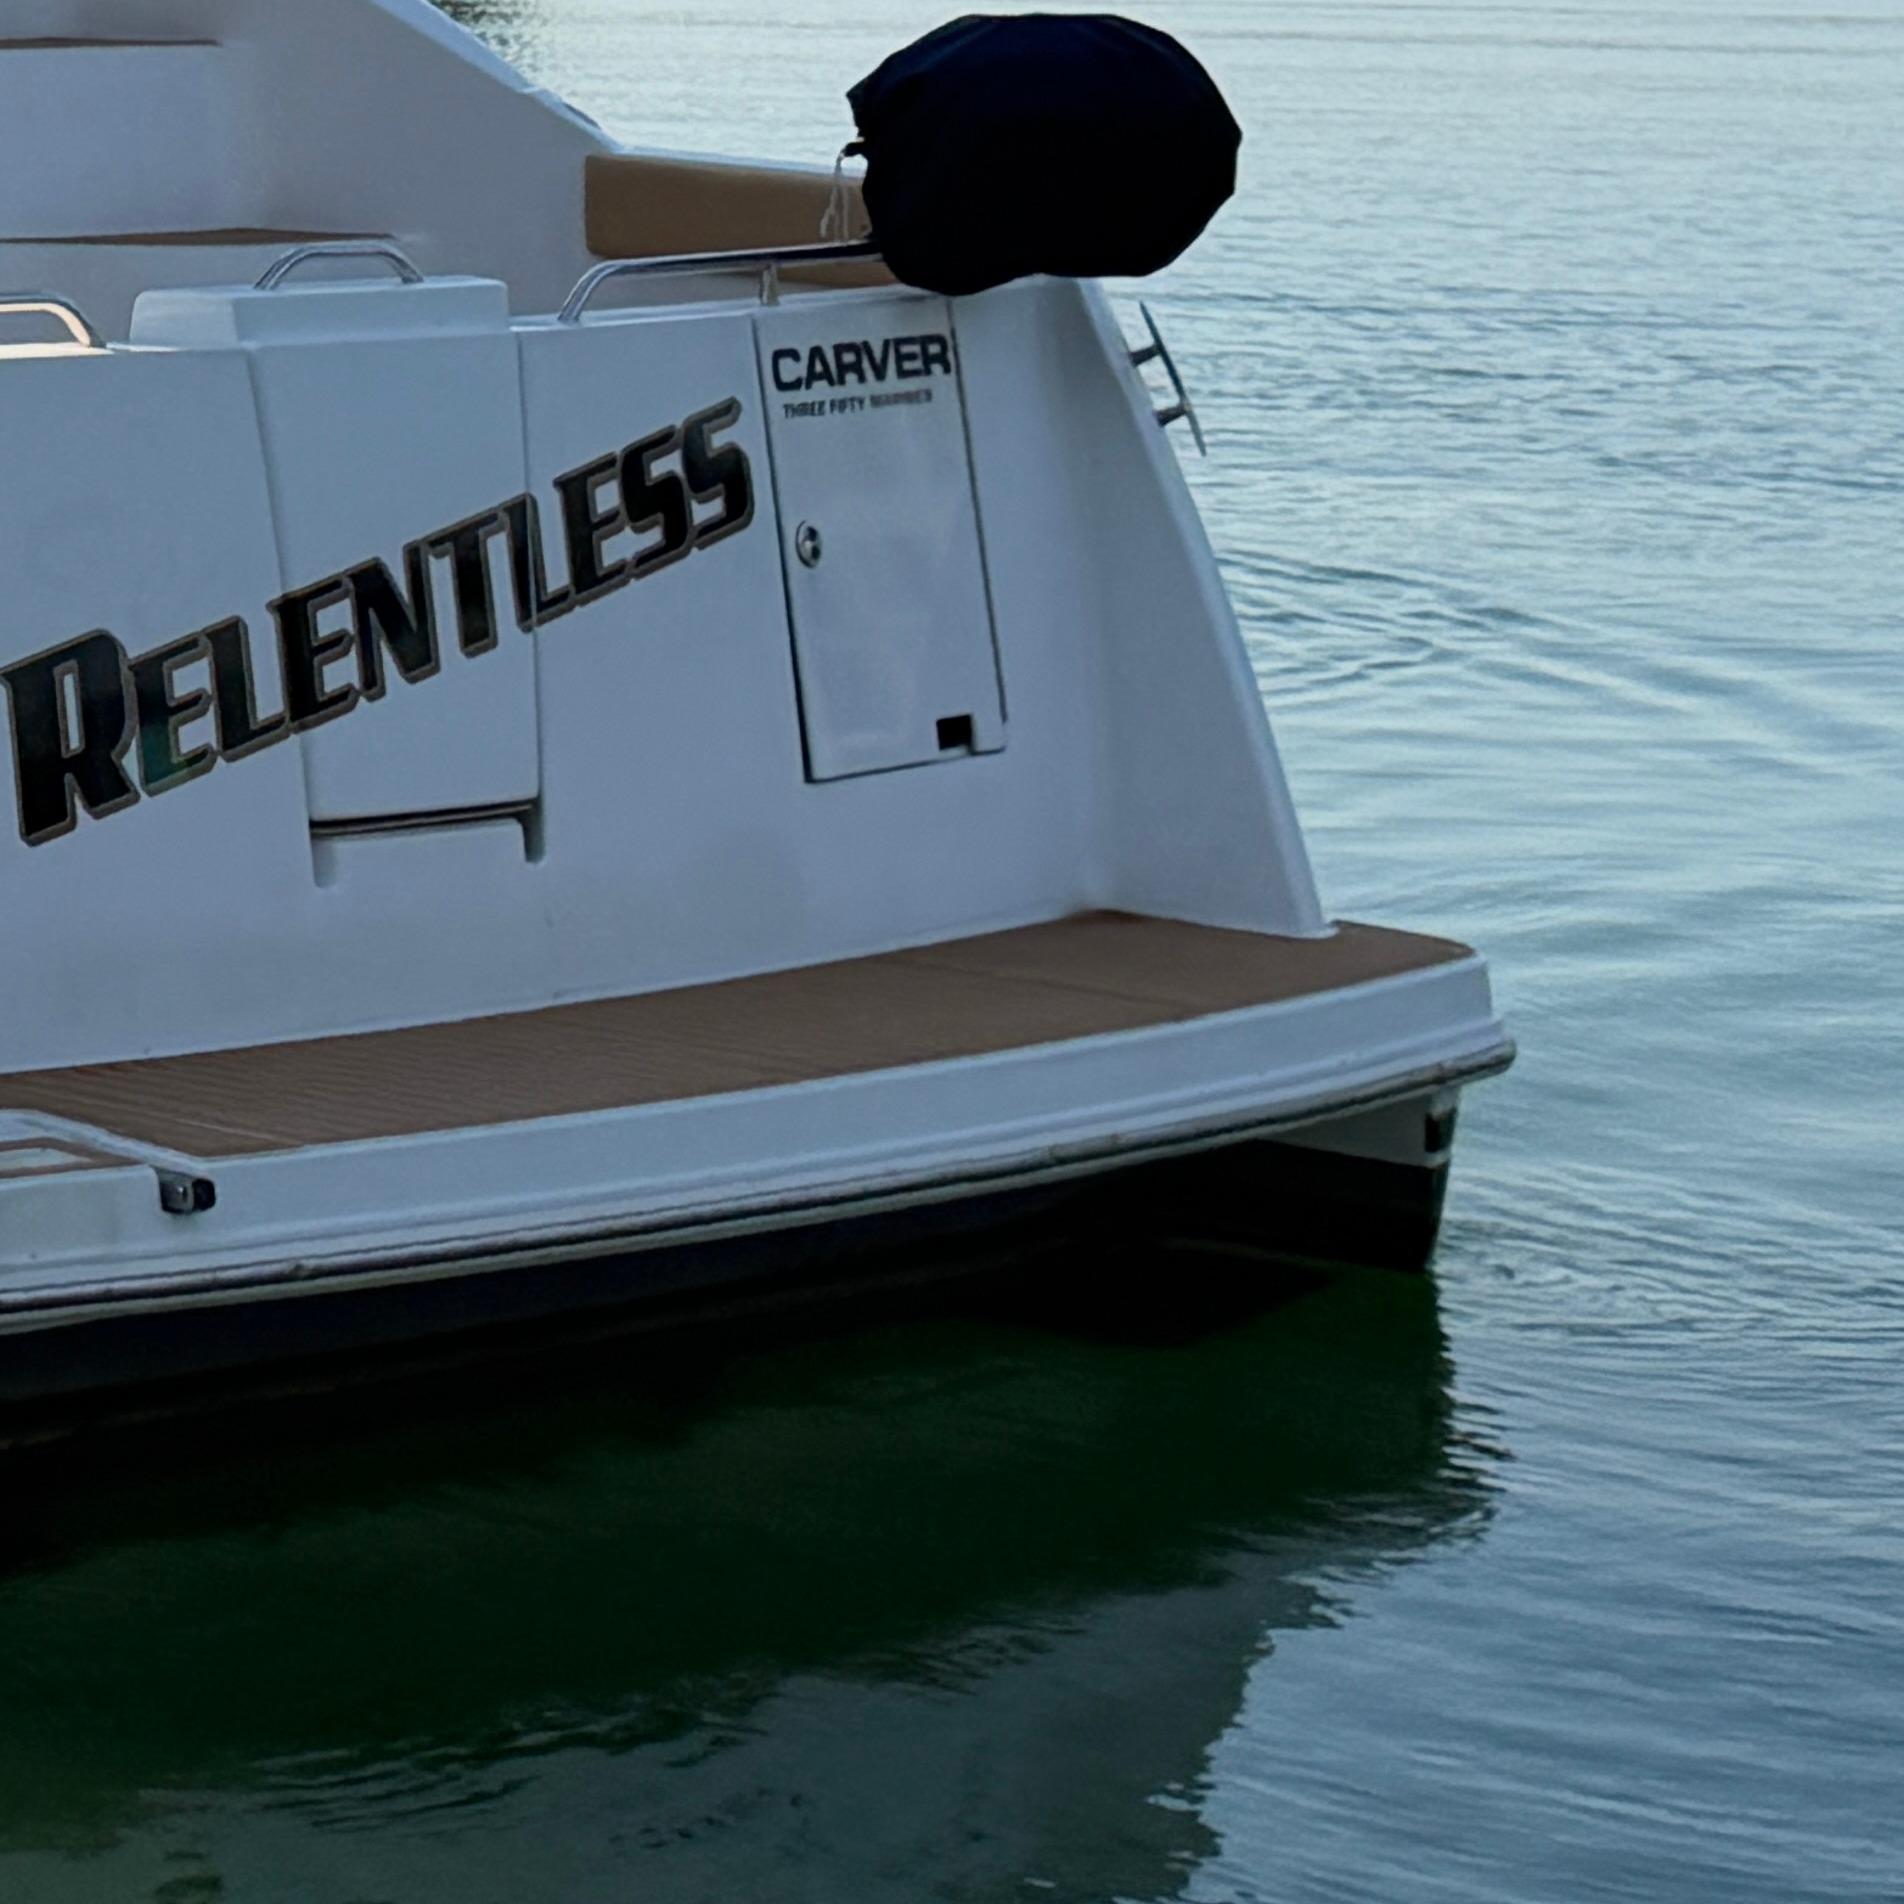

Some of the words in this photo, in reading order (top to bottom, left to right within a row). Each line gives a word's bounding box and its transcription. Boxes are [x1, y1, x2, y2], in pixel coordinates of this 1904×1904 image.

[772, 334, 952, 392] CARVER
[783, 399, 826, 419] THREE
[829, 396, 866, 415] FIFTY
